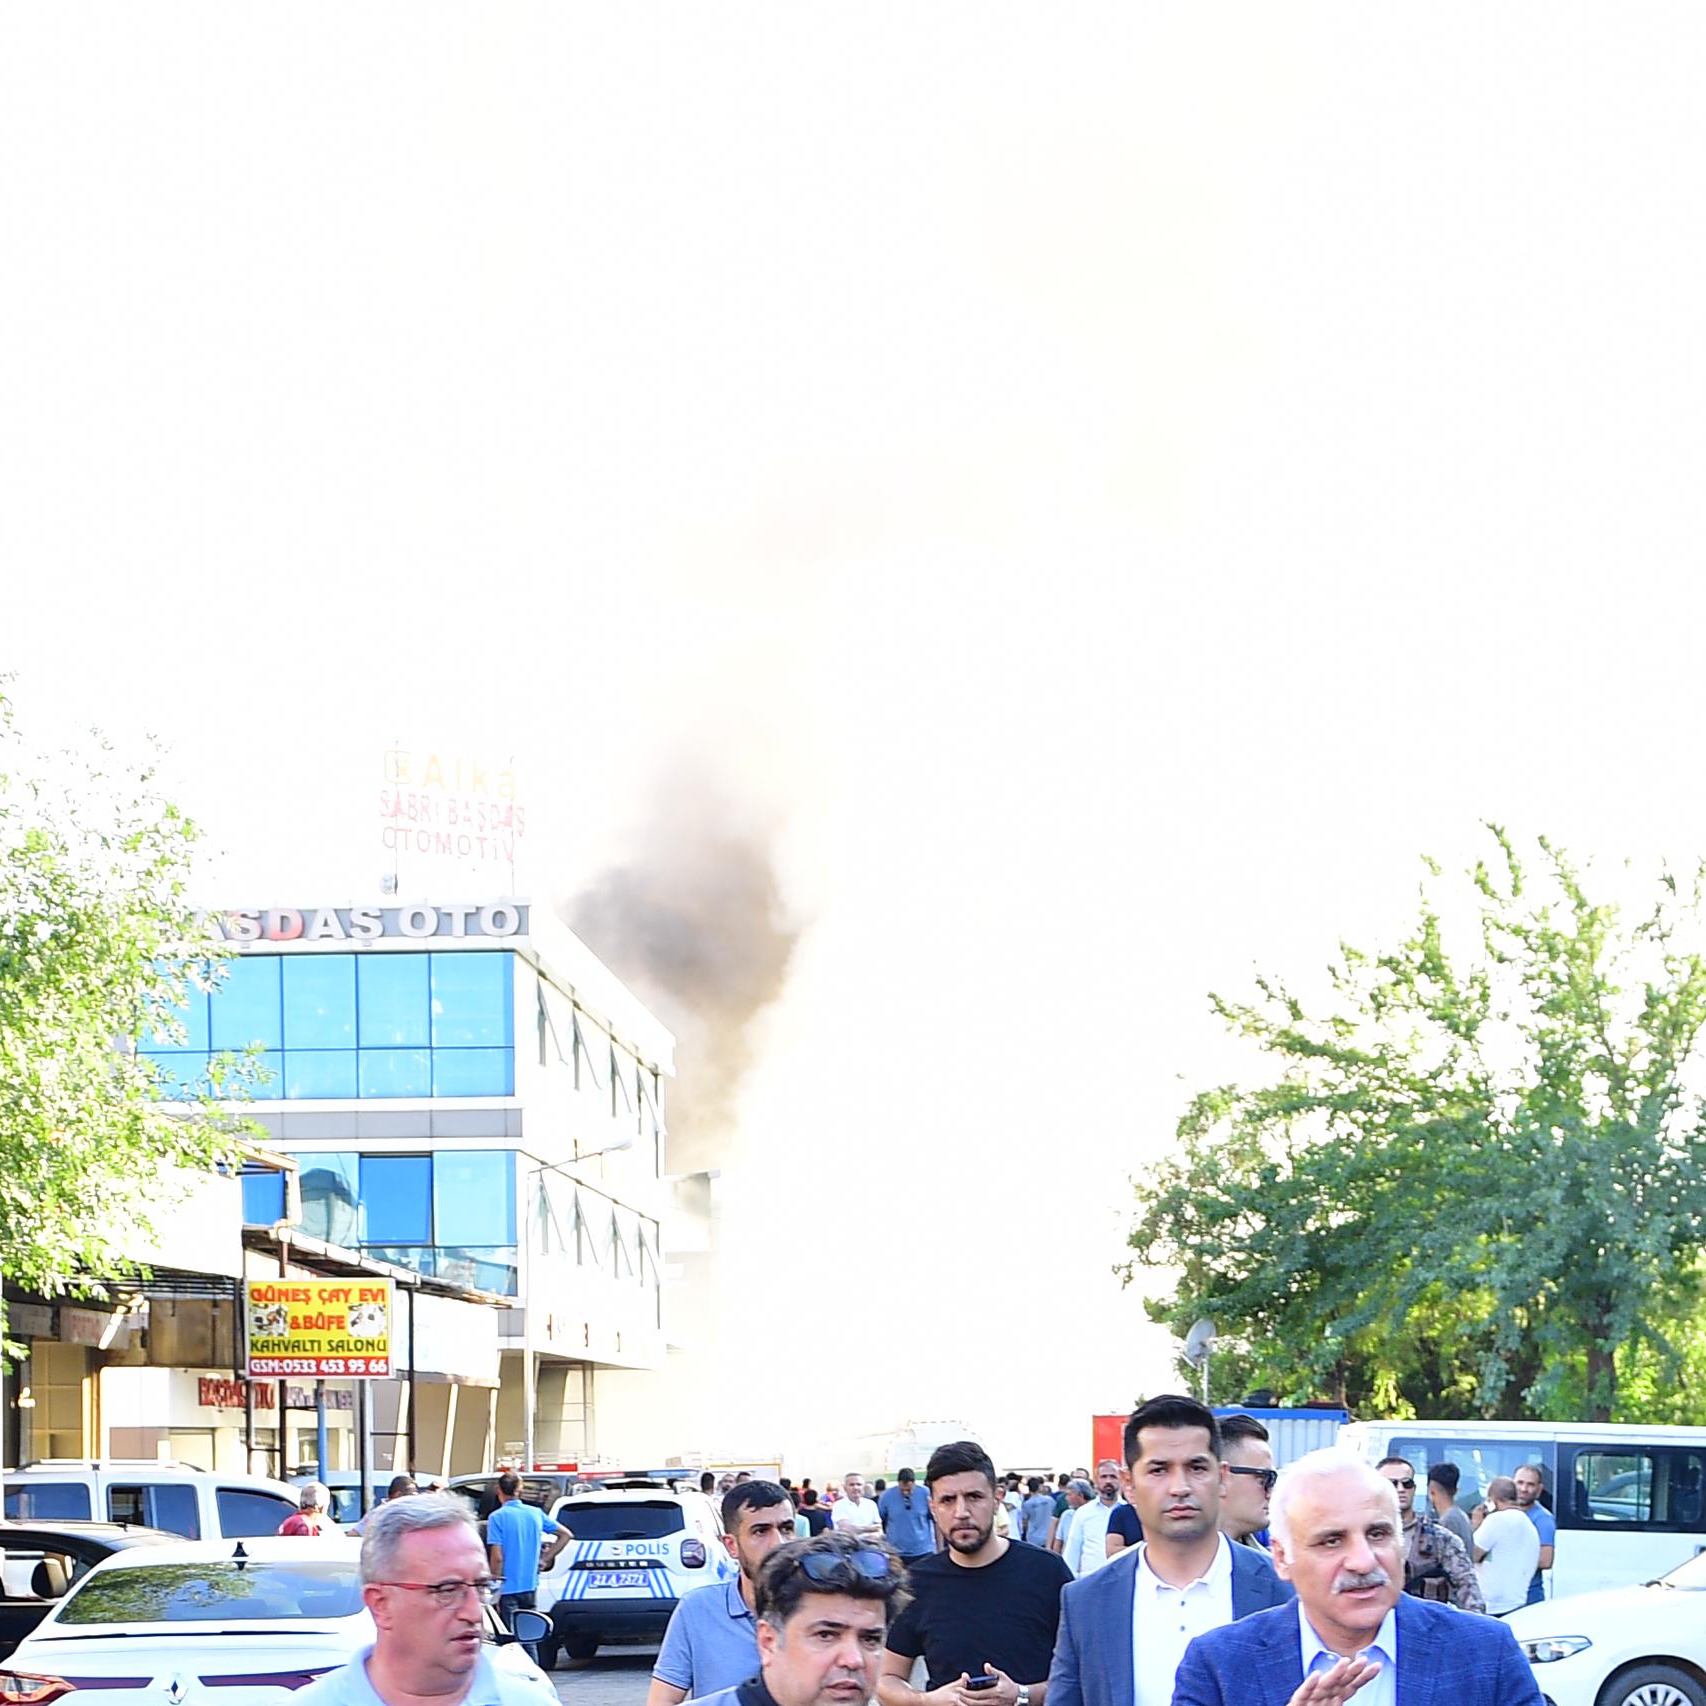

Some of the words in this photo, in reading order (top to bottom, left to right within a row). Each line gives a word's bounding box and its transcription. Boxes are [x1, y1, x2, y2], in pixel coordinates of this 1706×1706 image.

[398, 903, 521, 939] OTO
[250, 1285, 311, 1305] GÜNEŞ
[318, 1288, 352, 1305] ÇAY
[250, 1339, 322, 1353] KAHVALTI
[327, 1339, 387, 1353] SALONU
[320, 1359, 345, 1373] 453
[348, 1359, 366, 1373] 95
[369, 1359, 388, 1373] 66
[626, 1541, 670, 1556] POLİS
